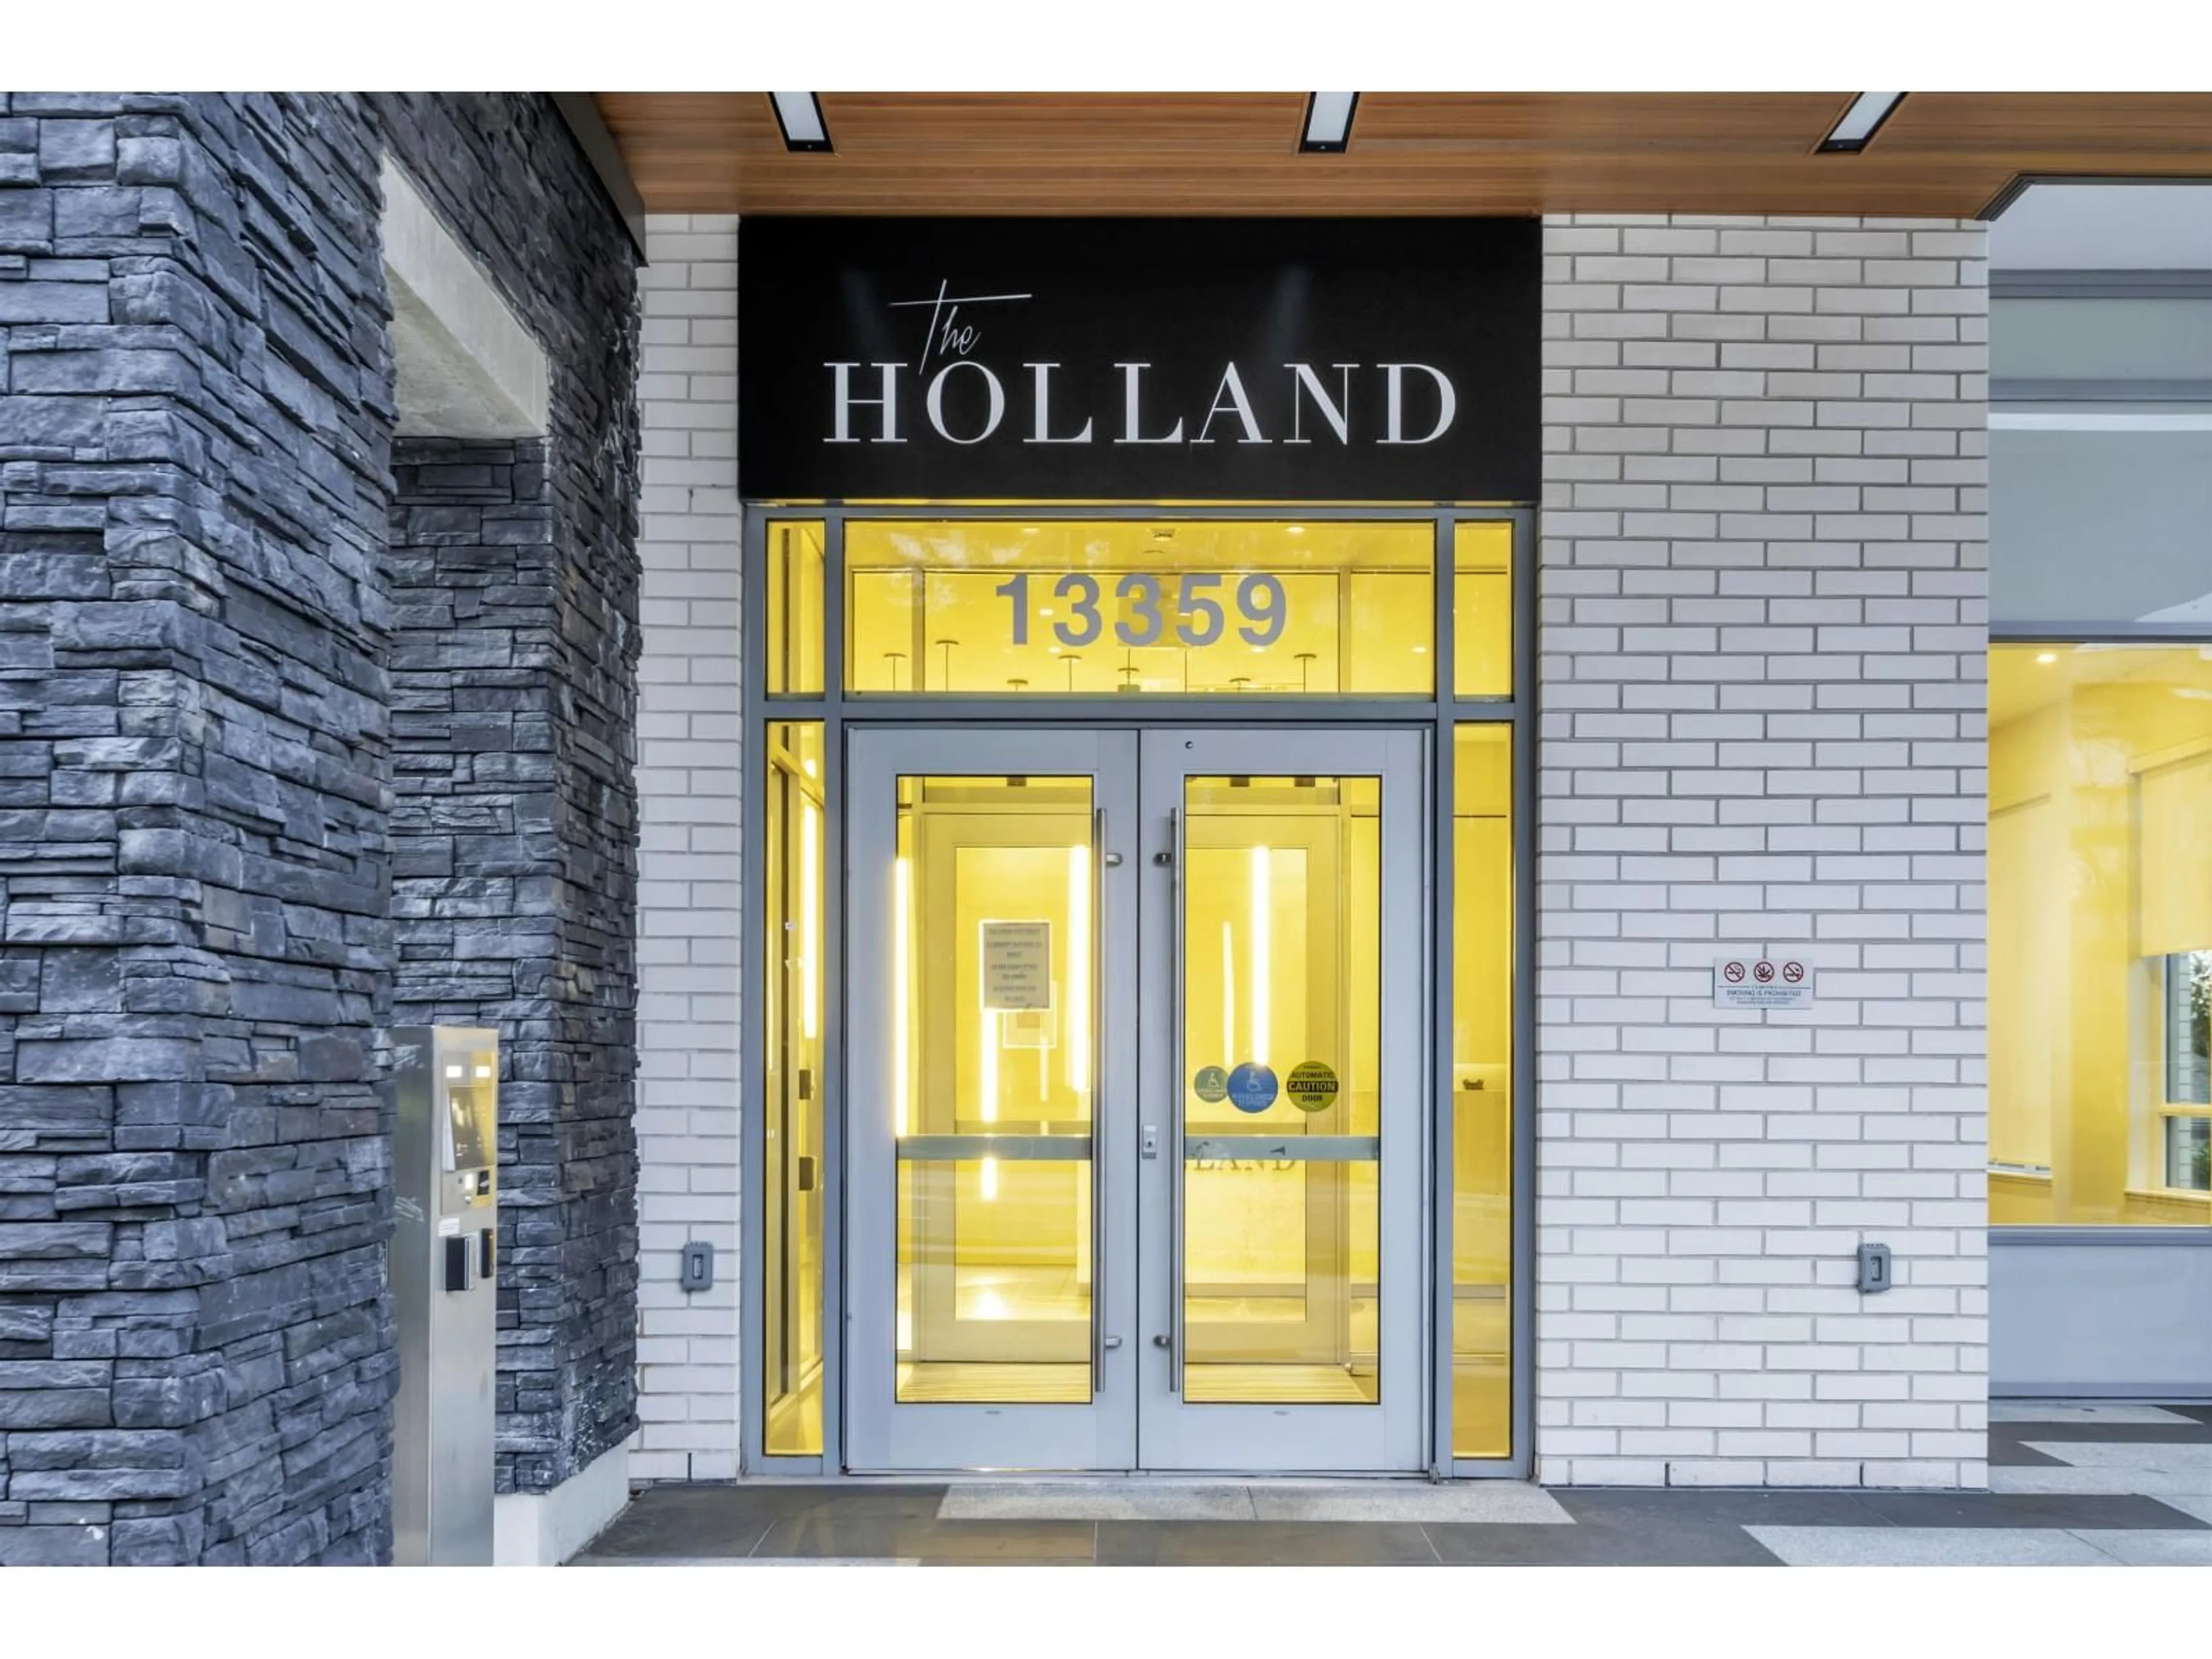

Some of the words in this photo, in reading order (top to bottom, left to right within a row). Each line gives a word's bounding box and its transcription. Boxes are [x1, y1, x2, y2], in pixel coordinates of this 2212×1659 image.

[823, 361, 1457, 445] HOLLAND
[995, 573, 1287, 647] 13359
[1288, 1082, 1336, 1091] CAUTION
